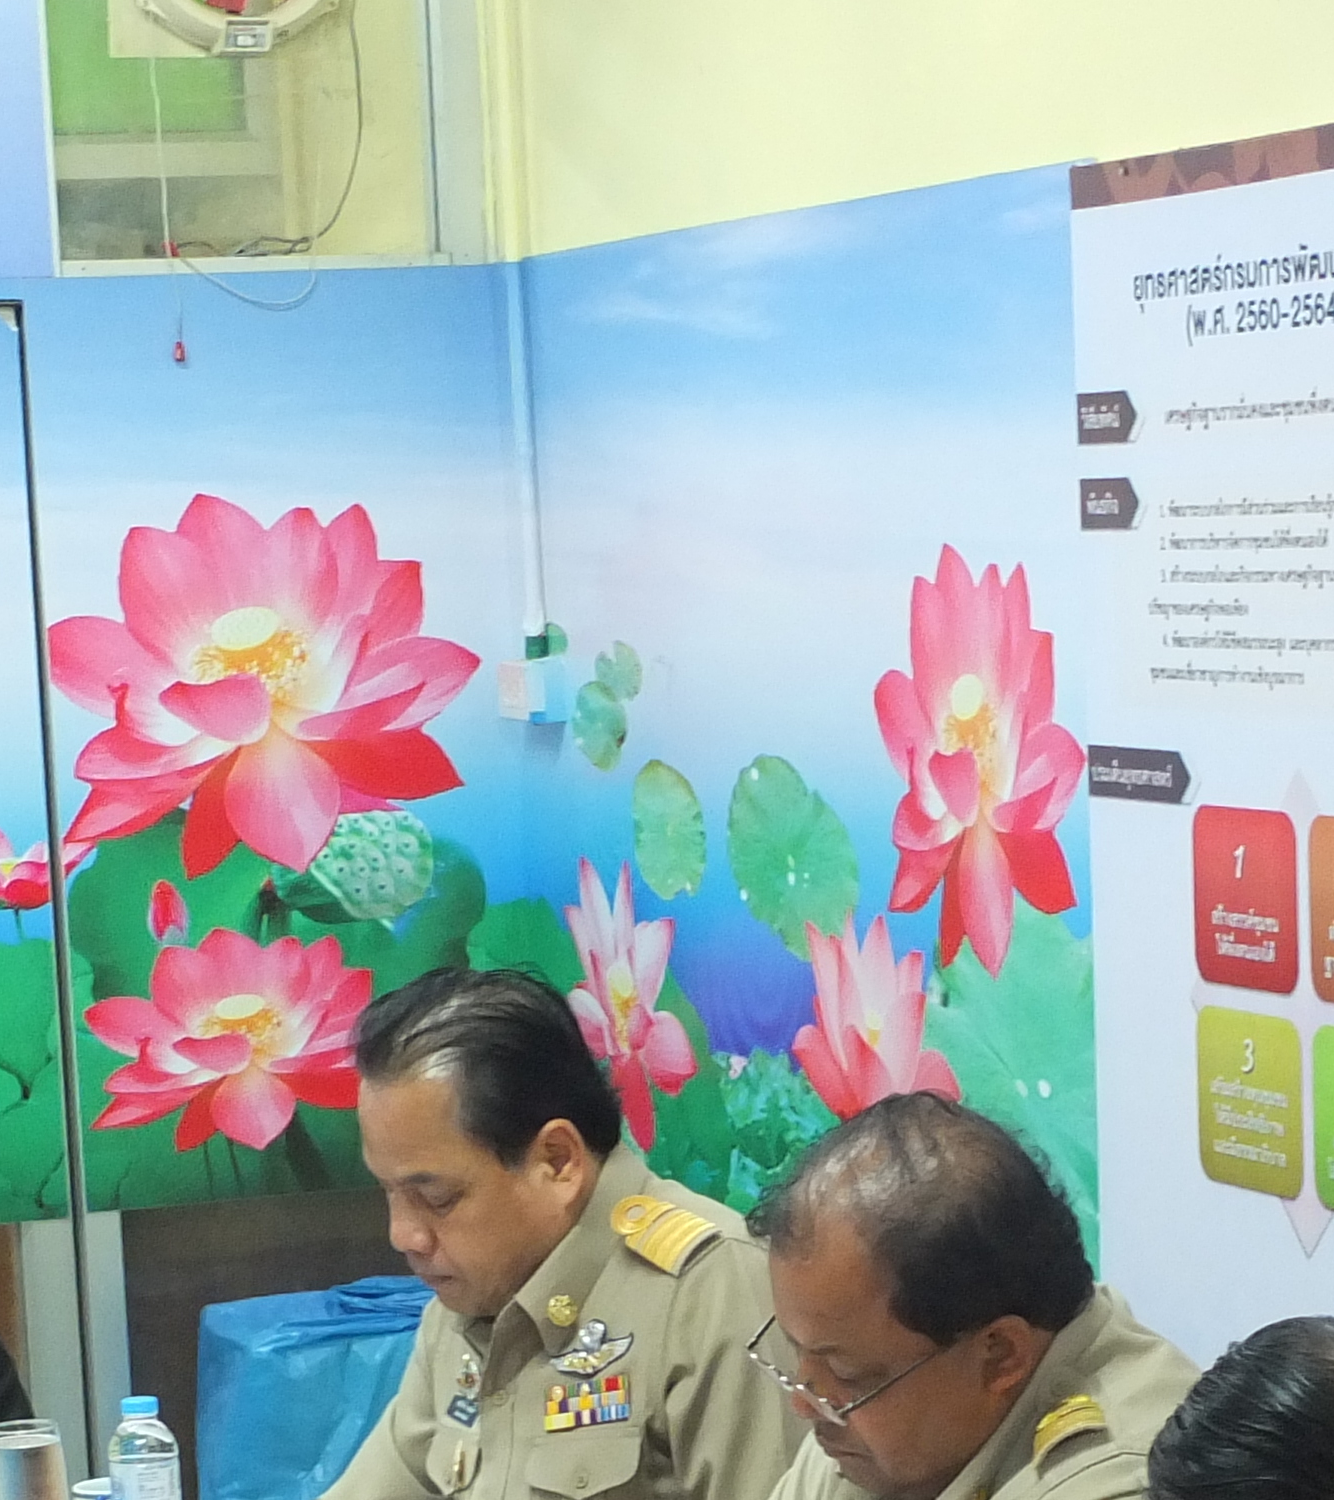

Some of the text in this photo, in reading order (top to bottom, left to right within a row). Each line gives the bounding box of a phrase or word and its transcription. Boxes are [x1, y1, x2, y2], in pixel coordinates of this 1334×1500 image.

[1186, 304, 1231, 346] (พ.ศ.
[1232, 844, 1247, 879] 1
[1240, 1038, 1256, 1074] 3
